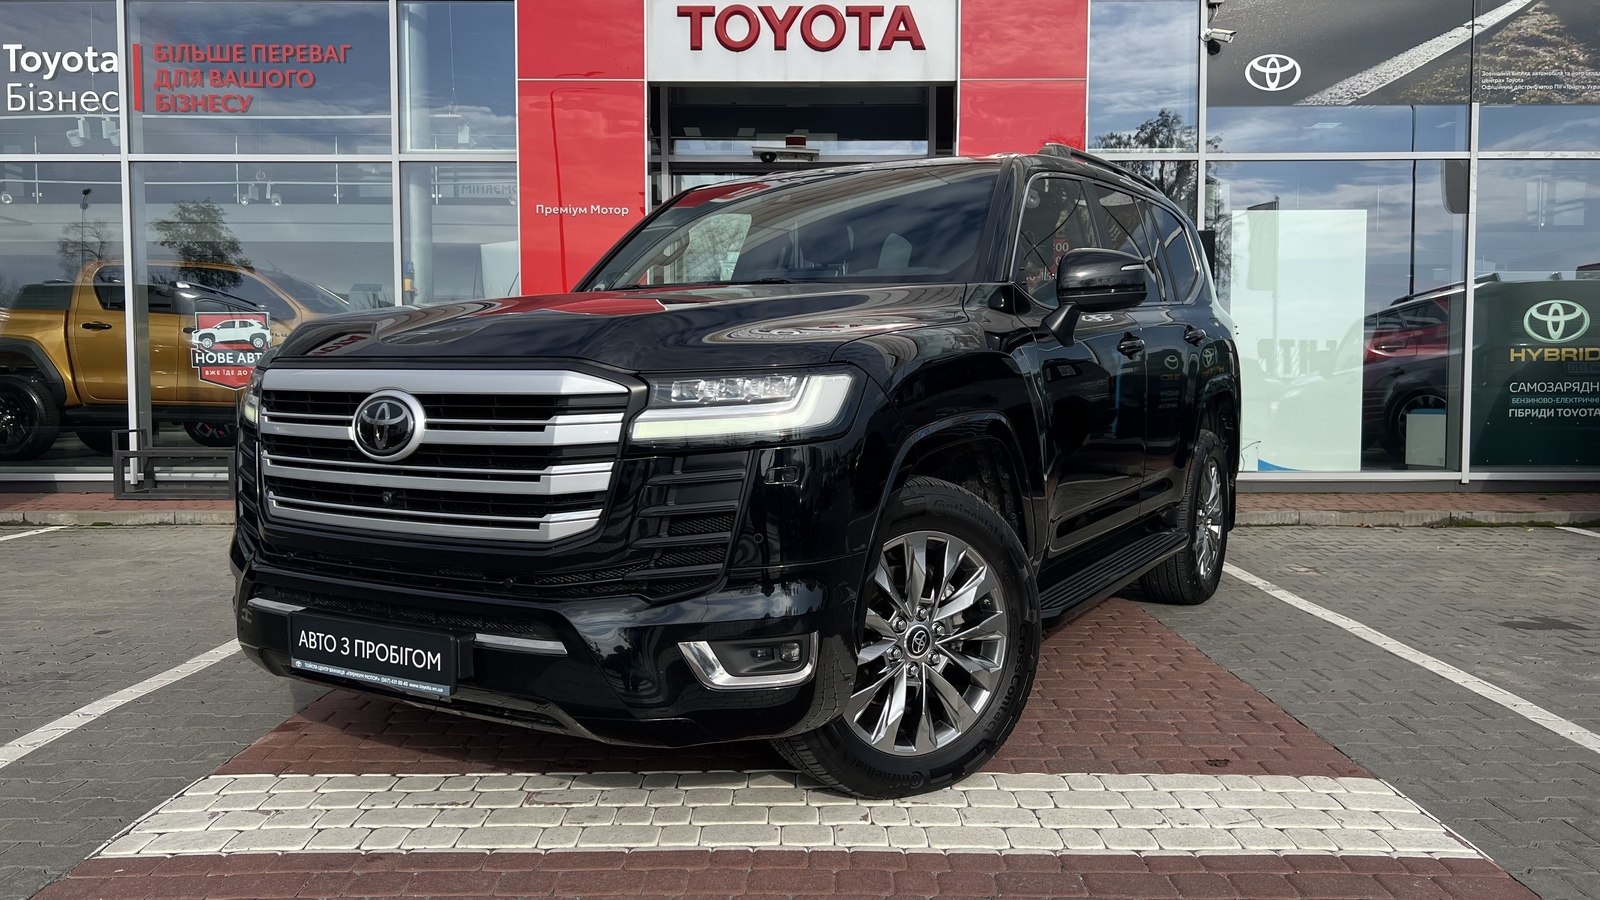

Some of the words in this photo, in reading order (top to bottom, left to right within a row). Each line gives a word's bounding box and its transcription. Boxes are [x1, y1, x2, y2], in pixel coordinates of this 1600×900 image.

[677, 4, 927, 52] TOYOTA
[3, 44, 119, 80] Toyota
[154, 44, 245, 63] БІЛЬШЕ
[252, 44, 352, 63] ПЕРЕВАГ
[154, 69, 203, 91] ДЛЯ
[210, 69, 315, 88] ВАШОГО
[6, 83, 119, 112] Бізнес
[156, 94, 253, 113] БІЗНЕСУ
[536, 205, 587, 217] Преміум
[591, 205, 629, 217] Мотор
[195, 352, 233, 364] НОВЕ
[237, 352, 263, 364] АВТ
[1509, 347, 1600, 362] HYBRID
[1509, 382, 1600, 394] САМОЗАРЯДН
[1508, 408, 1555, 418] ГІБРИДИ
[1556, 408, 1600, 418] TOYOTA
[298, 630, 337, 653] АВТО
[340, 637, 350, 656] З
[354, 639, 441, 671] ПРОБІГОМ
